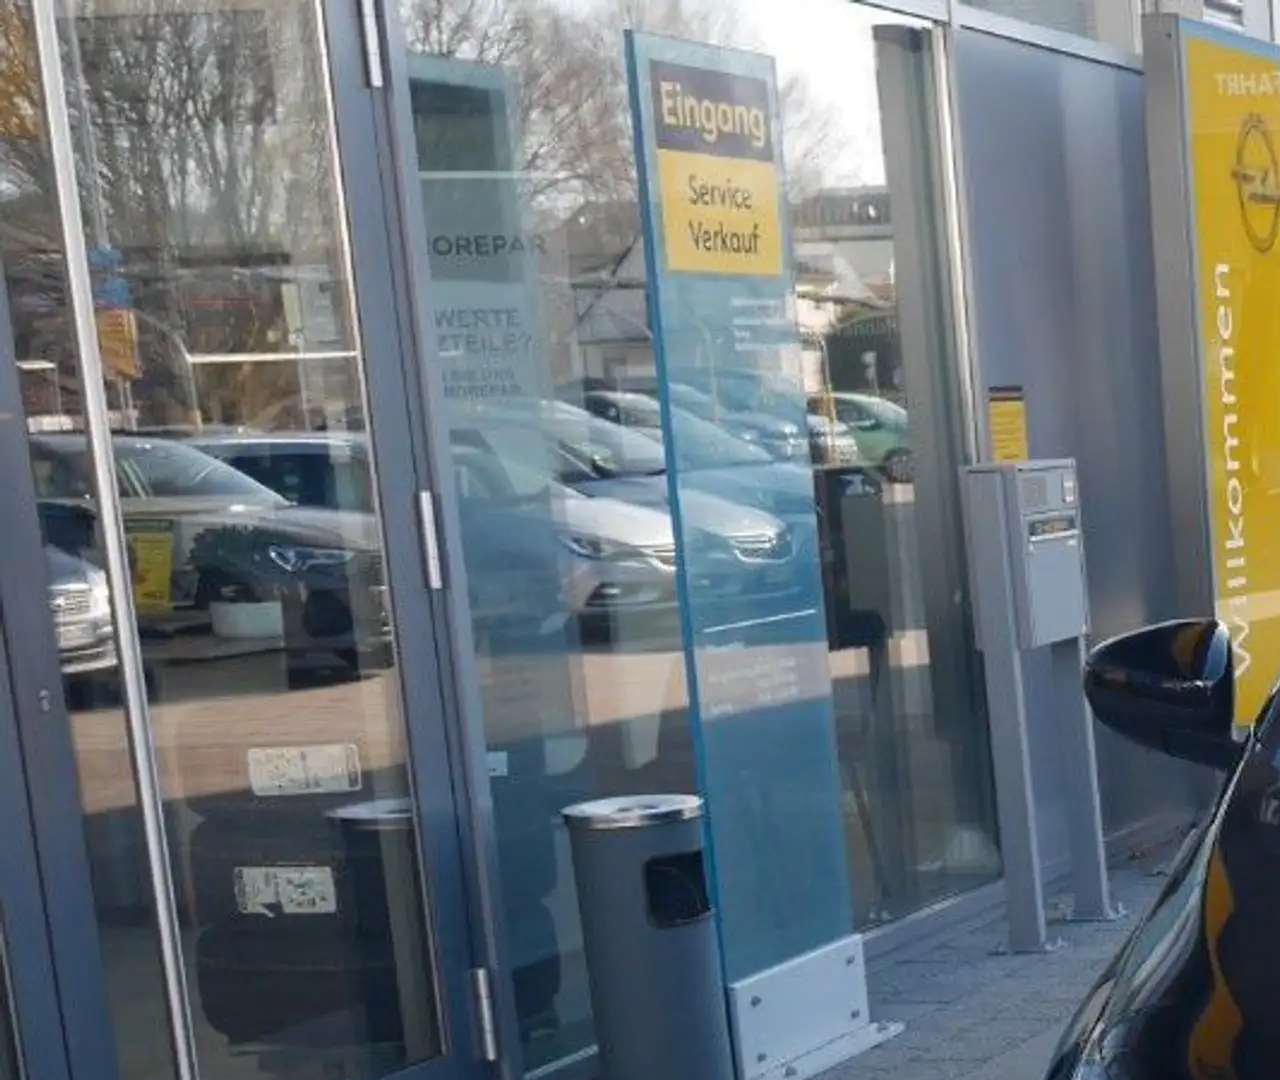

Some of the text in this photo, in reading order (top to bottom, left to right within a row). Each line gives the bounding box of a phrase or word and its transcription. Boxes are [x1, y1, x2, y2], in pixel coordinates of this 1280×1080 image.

[659, 80, 766, 148] Eingang
[688, 174, 752, 210] Service
[688, 219, 761, 255] Verkauf
